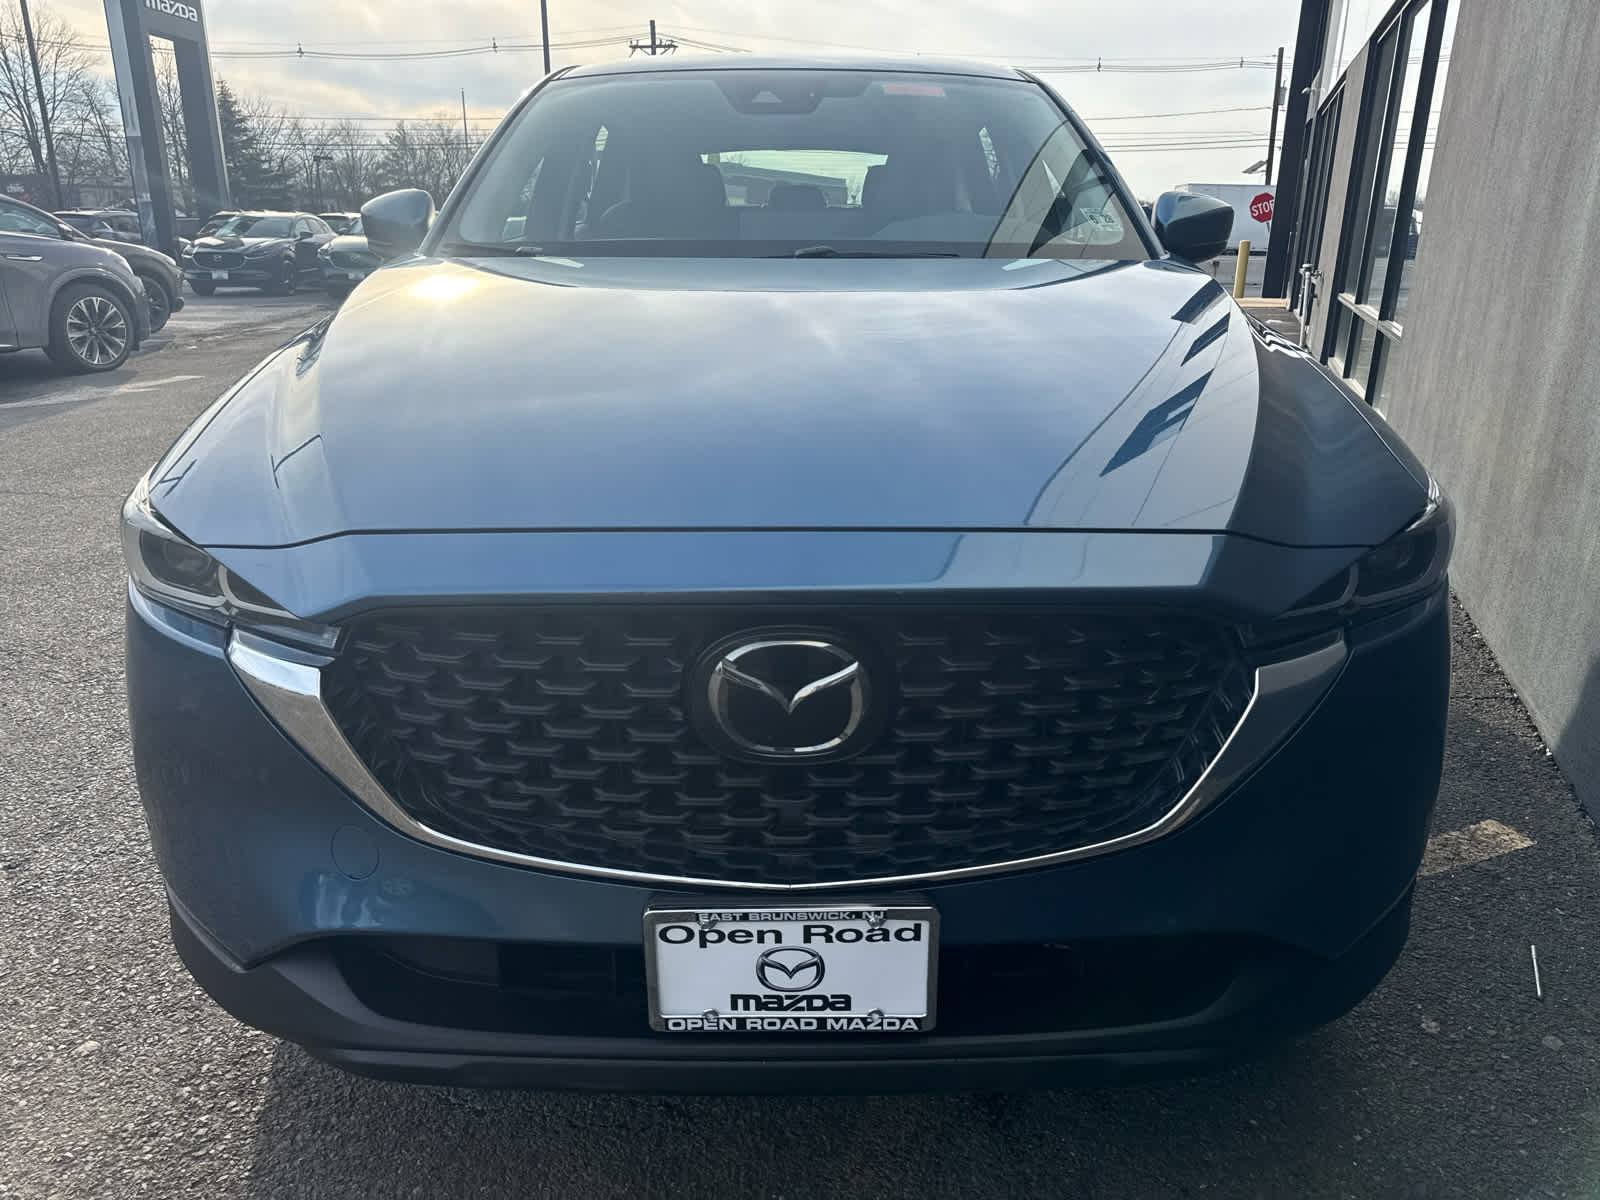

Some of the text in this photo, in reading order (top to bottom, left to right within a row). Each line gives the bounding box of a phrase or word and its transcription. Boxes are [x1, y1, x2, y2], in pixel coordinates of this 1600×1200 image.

[698, 911, 884, 921] EAST BRUNSWICK, NJ
[658, 923, 922, 949] Open Road
[667, 1018, 919, 1031] OPEN ROAD MAZDA
